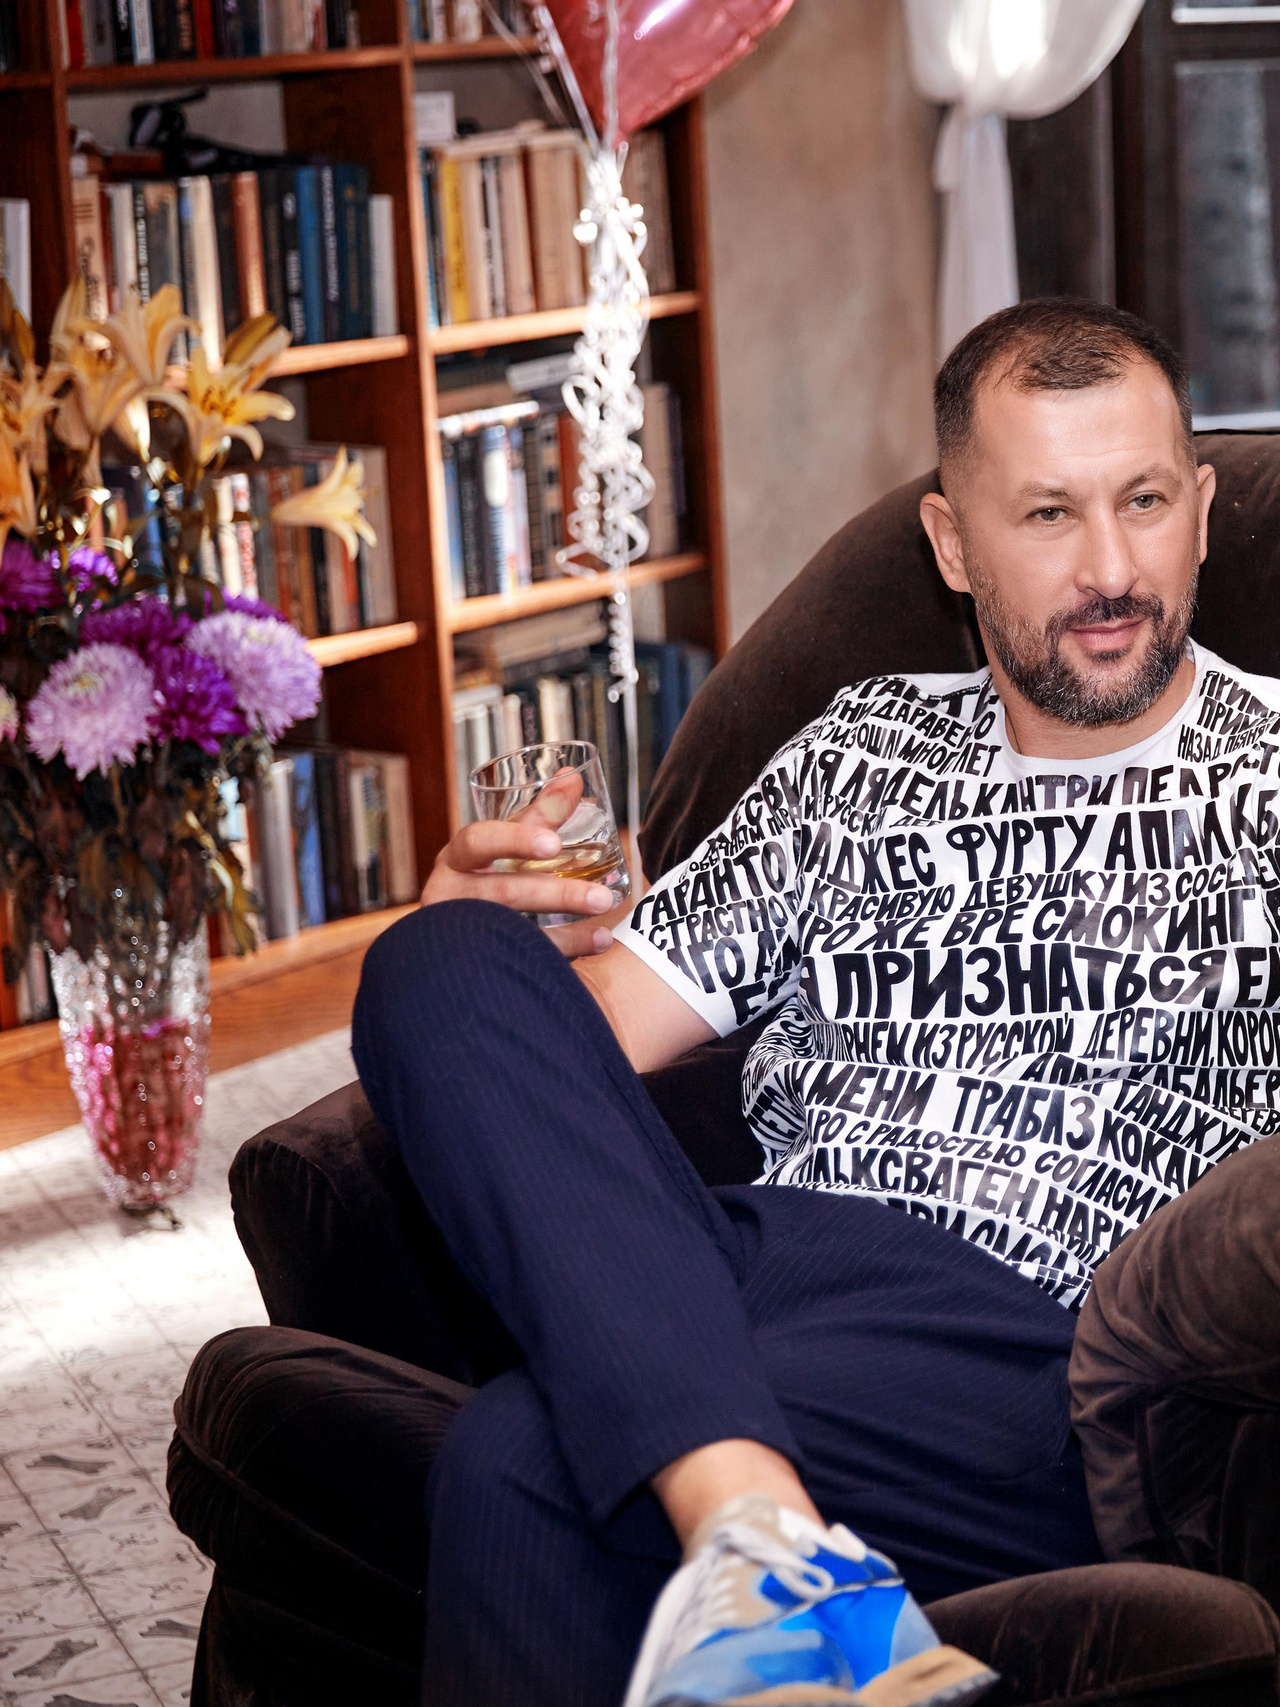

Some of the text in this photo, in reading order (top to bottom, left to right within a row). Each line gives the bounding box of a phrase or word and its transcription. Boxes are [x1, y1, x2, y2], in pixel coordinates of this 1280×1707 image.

[630, 841, 788, 930] ГАРАНТО
[946, 814, 1098, 882] ФУРТУ
[960, 869, 1118, 912] ДЕВУШКУ
[1122, 871, 1171, 906] ИЗ
[1033, 888, 1256, 953] СМОКИНГ
[832, 941, 1228, 1019] ПРИЗНАТЬСЯ
[865, 1123, 1027, 1168] РАДОСТЬЮ
